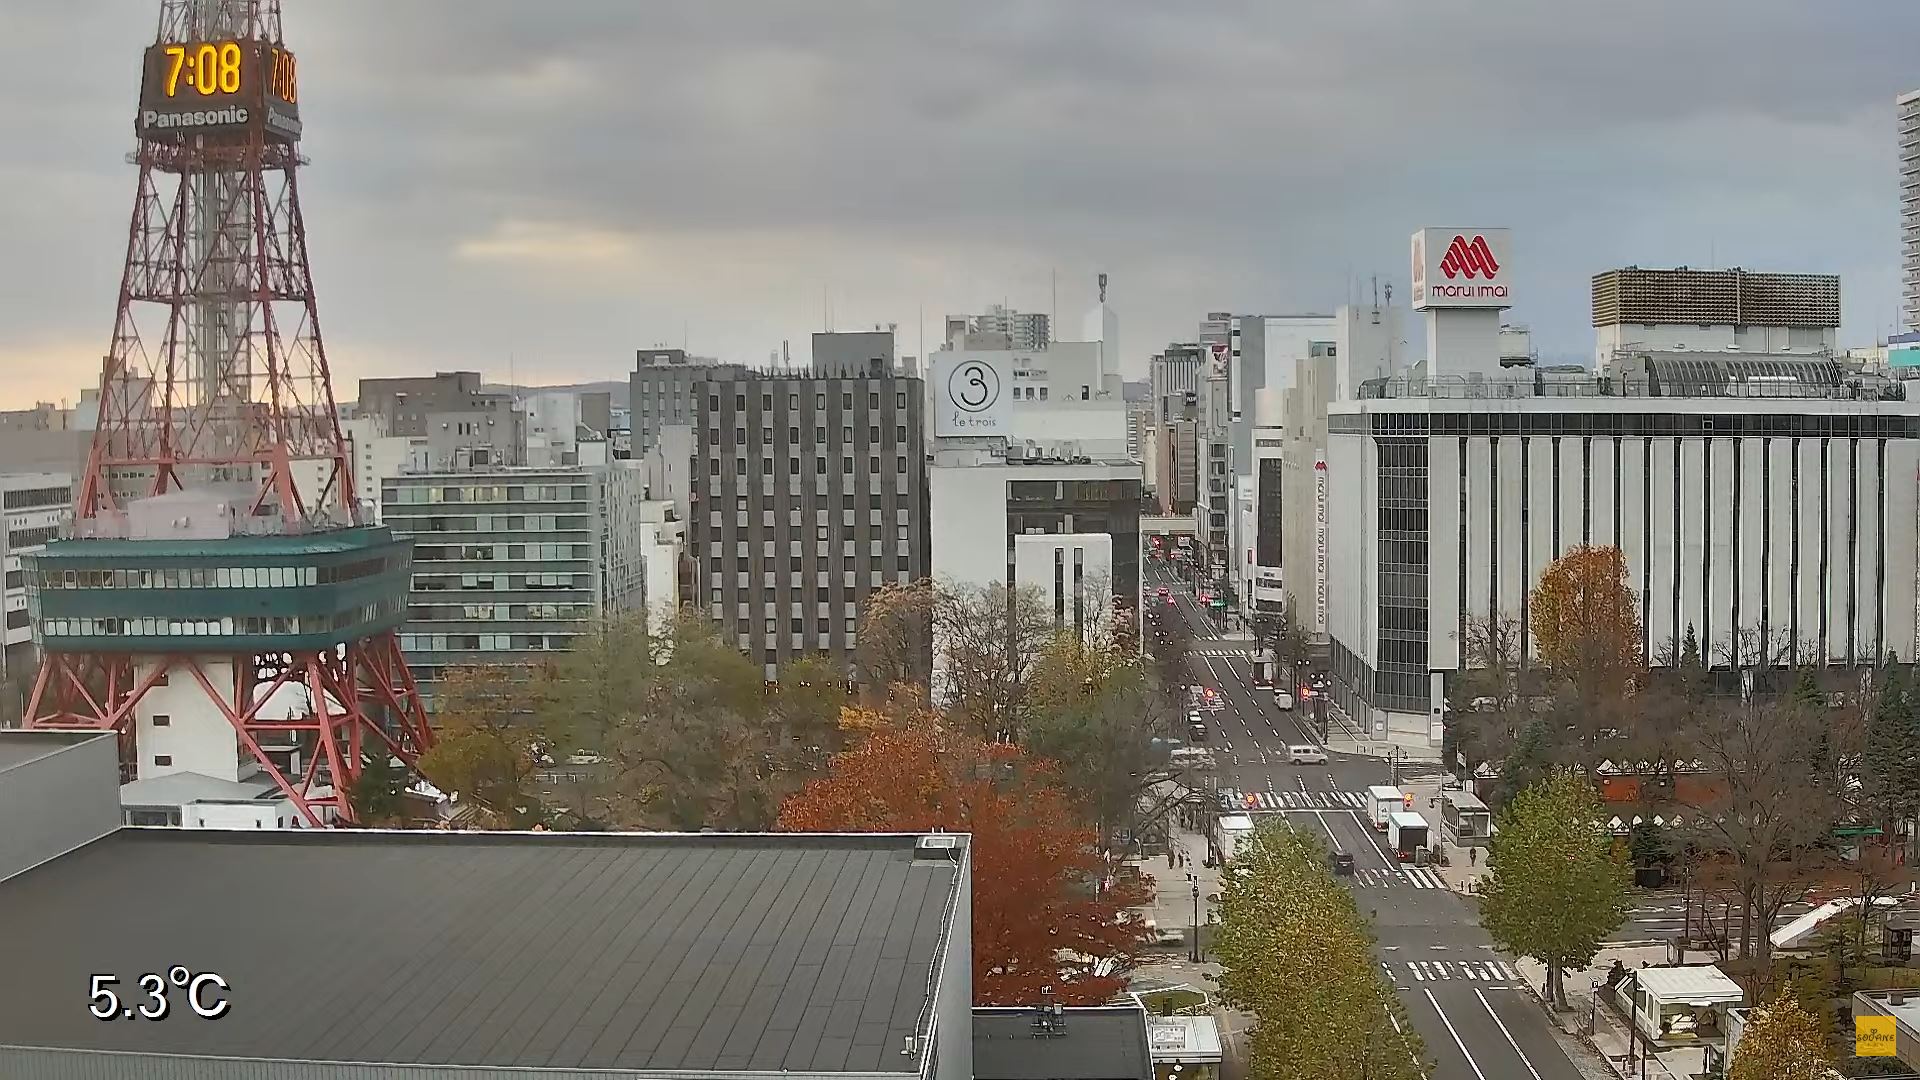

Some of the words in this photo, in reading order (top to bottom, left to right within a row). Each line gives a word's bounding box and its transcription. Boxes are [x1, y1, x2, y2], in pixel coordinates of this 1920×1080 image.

[165, 43, 241, 97] 7:08
[271, 48, 297, 104] 7:08
[143, 104, 249, 128] Panasonic
[1432, 285, 1475, 297] marui
[1477, 285, 1508, 297] imai
[960, 366, 988, 406] 3
[952, 411, 966, 427] le
[969, 416, 997, 427] trois
